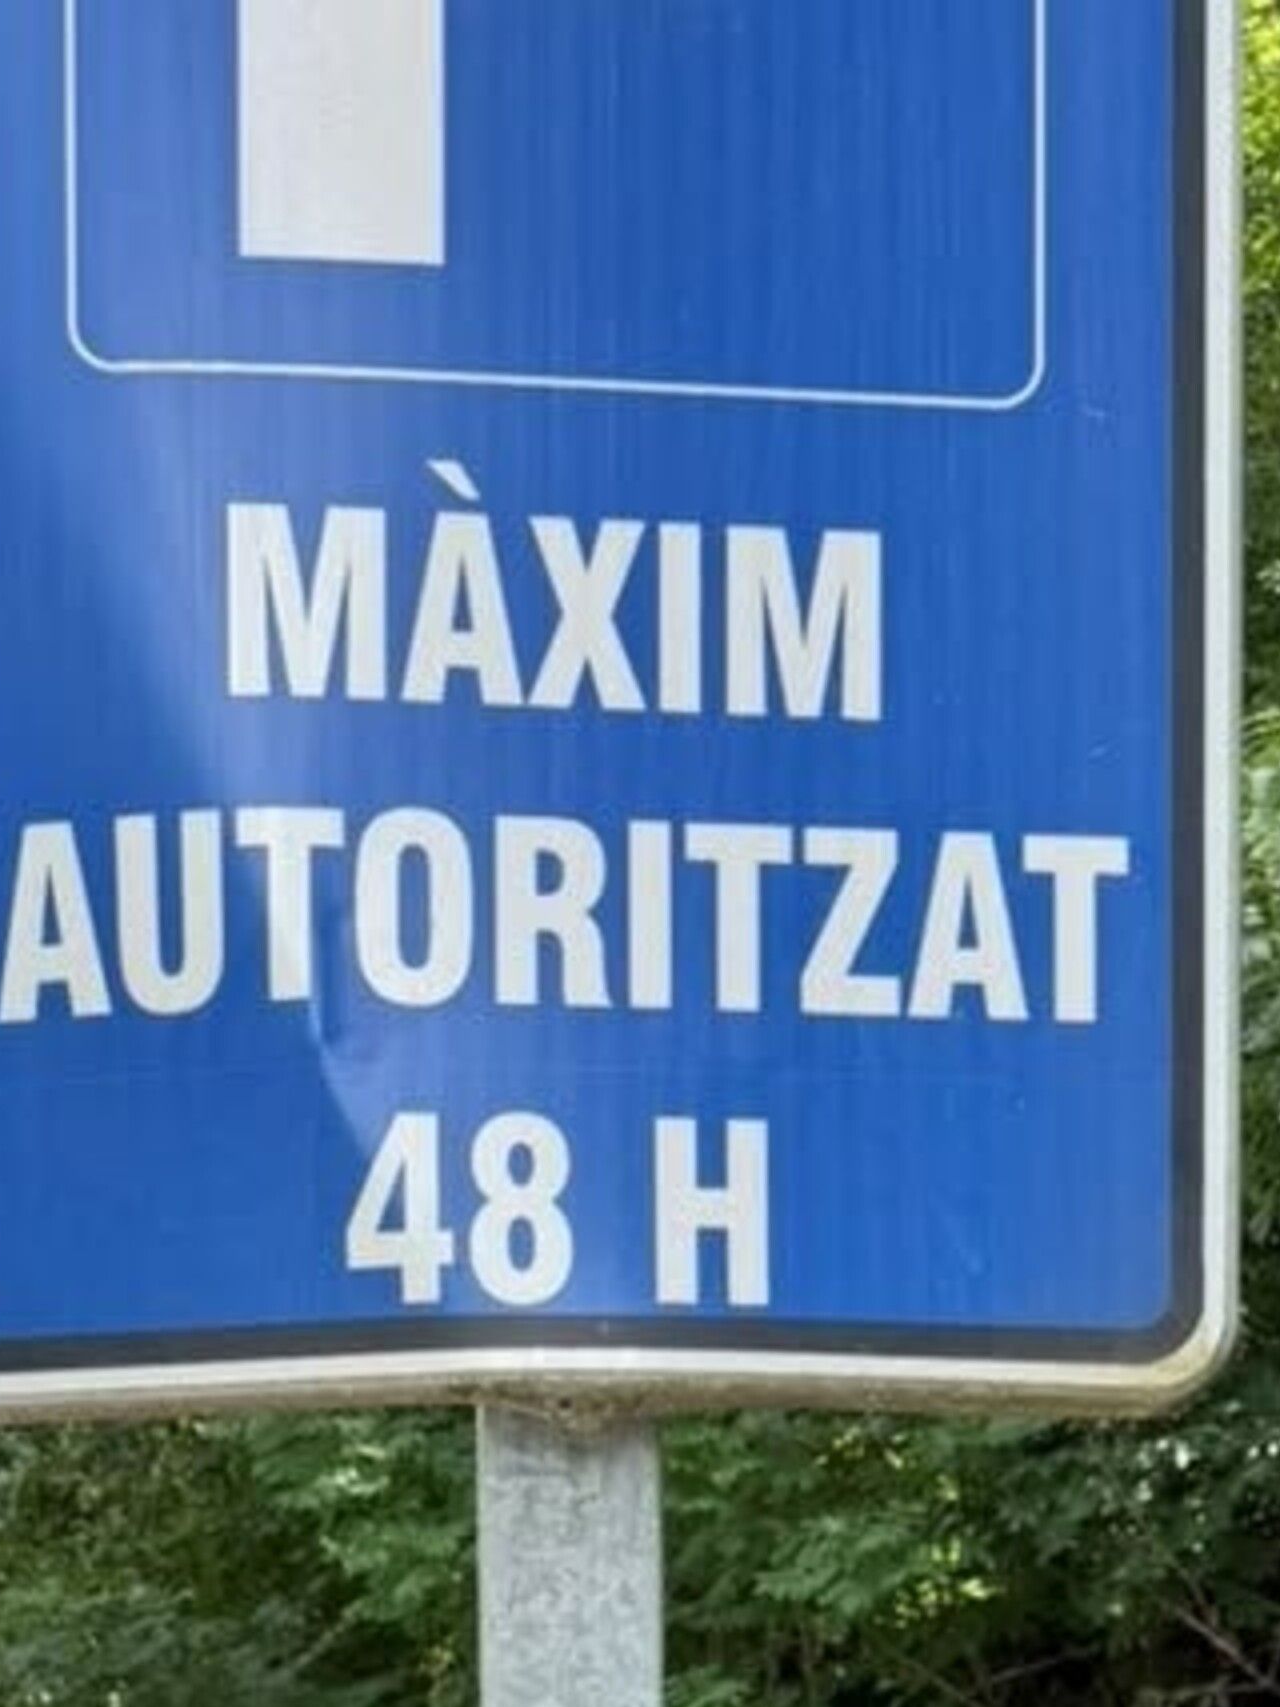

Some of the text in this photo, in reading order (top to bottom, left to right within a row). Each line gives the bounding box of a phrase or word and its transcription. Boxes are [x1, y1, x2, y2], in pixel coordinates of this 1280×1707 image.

[225, 459, 882, 721] MÀXIM
[346, 1110, 770, 1307] 48 H
